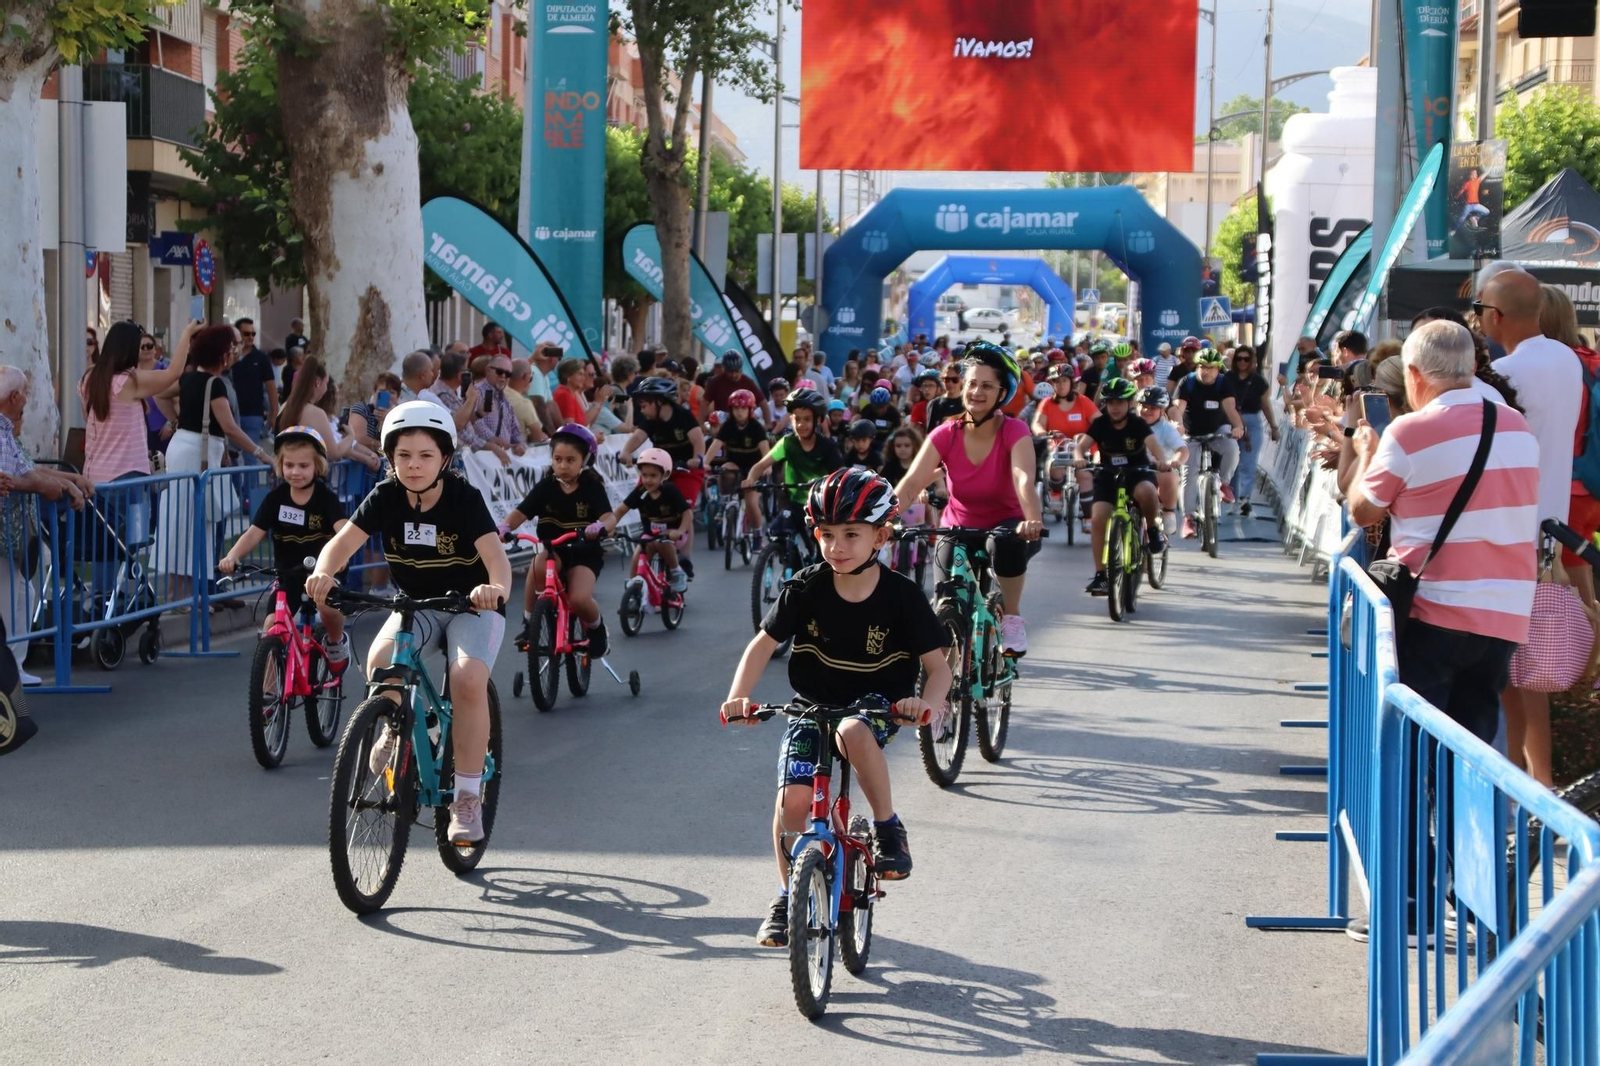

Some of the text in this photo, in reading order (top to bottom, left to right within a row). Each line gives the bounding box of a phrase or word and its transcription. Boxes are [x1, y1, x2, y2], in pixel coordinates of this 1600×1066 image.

[546, 4, 596, 13] DIPUTACIÓN
[547, 12, 595, 21] DE ALMERÍA
[953, 37, 1034, 59] ¡VAMOS!
[545, 77, 567, 90] LA
[975, 206, 1079, 234] cajamar
[552, 228, 597, 241] cajamar
[1026, 228, 1076, 236] CAJA RURAL
[165, 245, 191, 258] AXA
[828, 324, 865, 335] cajamar
[1152, 327, 1190, 338] cajamar
[282, 511, 298, 520] 332
[407, 530, 421, 540] 22
